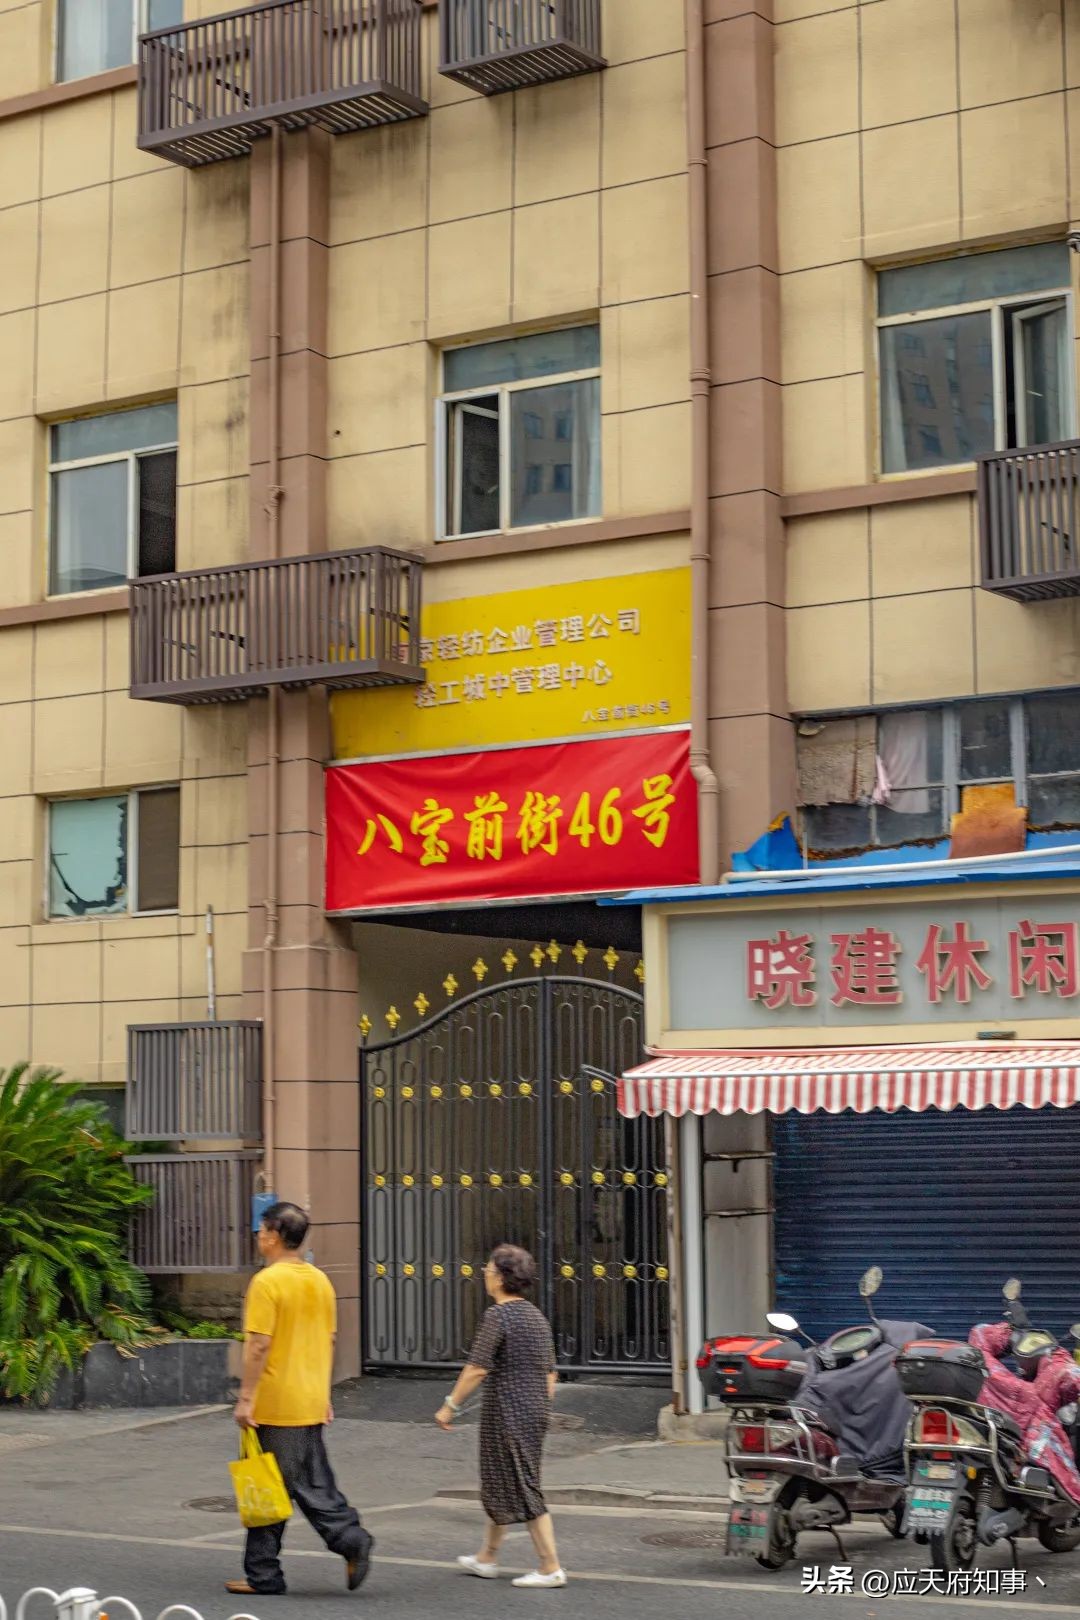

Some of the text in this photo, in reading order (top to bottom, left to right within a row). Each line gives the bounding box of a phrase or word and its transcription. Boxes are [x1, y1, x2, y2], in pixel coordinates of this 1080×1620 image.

[357, 773, 676, 867] 八宝前街46号
[745, 919, 1080, 1009] 晓建休闲
